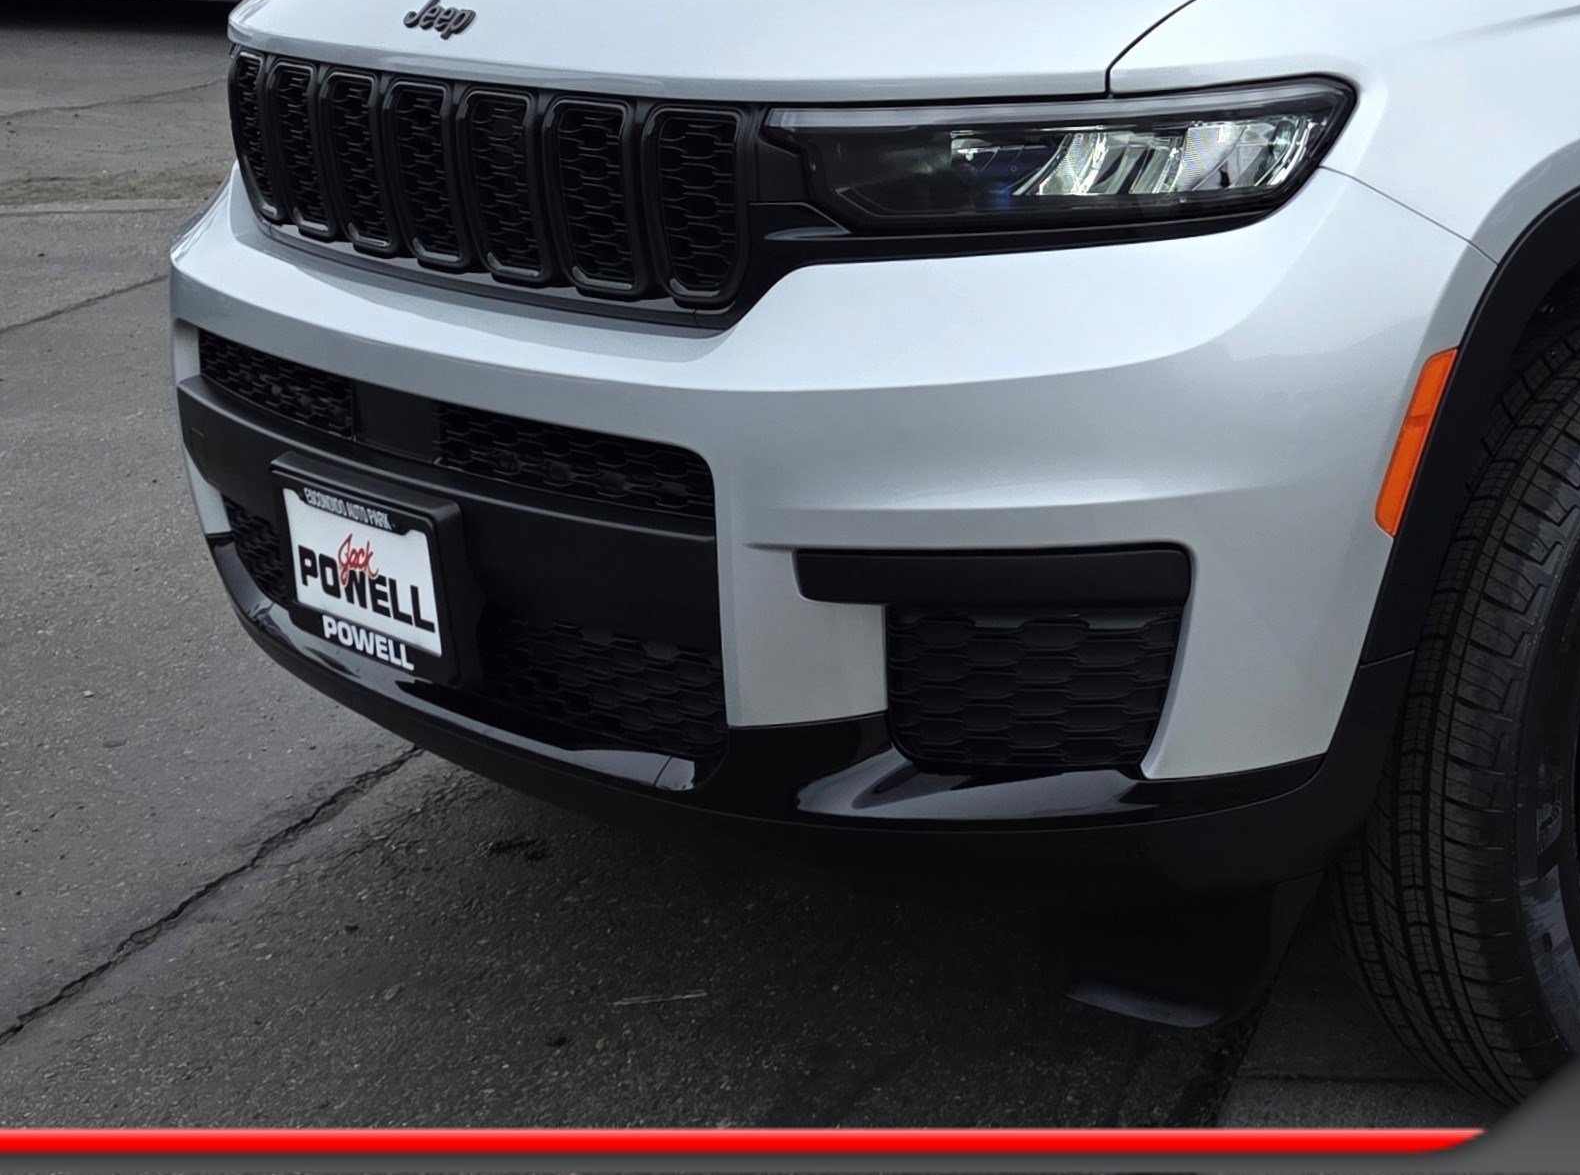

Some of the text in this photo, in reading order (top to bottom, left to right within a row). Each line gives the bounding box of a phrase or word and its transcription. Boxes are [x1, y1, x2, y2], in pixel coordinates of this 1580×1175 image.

[303, 487, 392, 531] ESCONDIDO AUTO PARK
[338, 533, 379, 588] Jack
[298, 544, 435, 634] POWELL
[322, 614, 415, 671] POWELL
